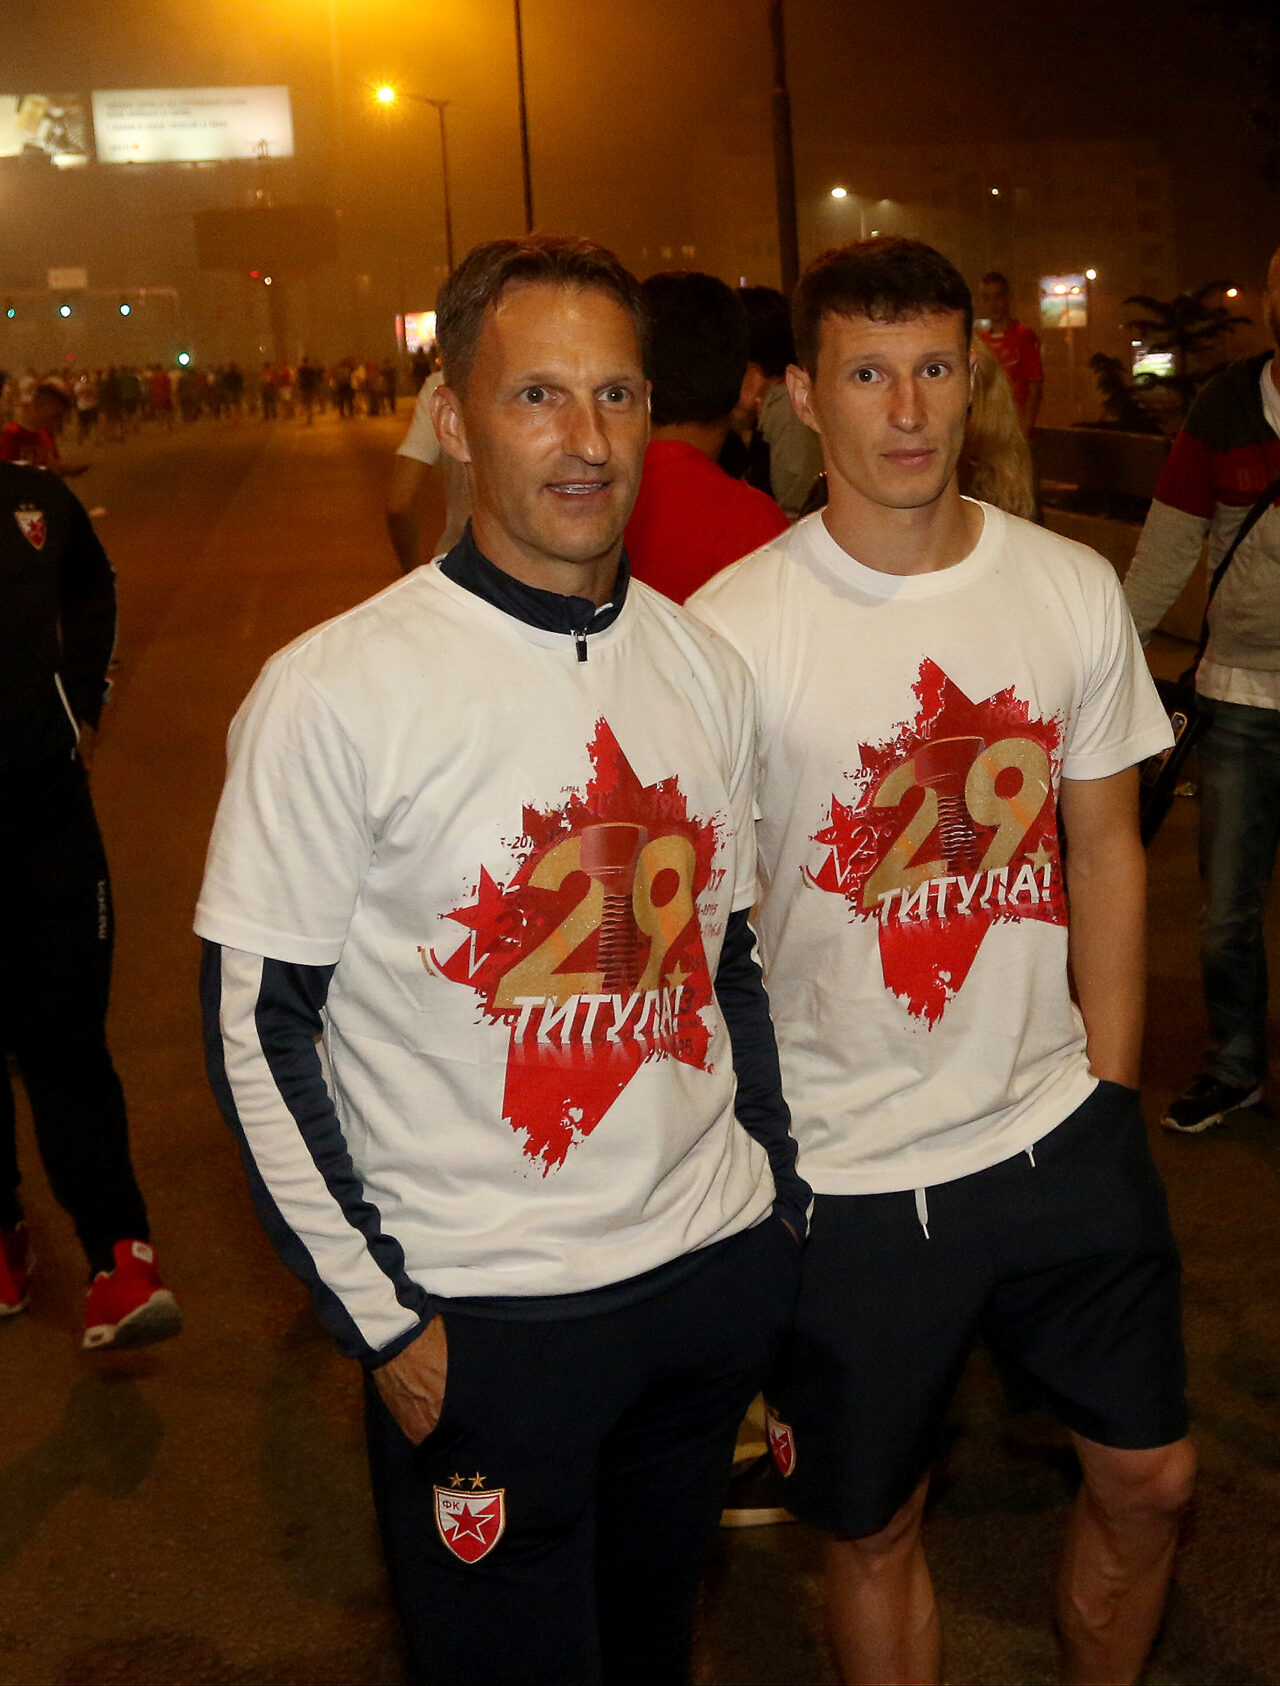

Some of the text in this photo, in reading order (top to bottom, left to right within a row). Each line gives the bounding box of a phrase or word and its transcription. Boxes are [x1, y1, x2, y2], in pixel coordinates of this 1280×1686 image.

[863, 737, 1051, 909] 29
[493, 835, 697, 1009] 29
[877, 863, 1052, 927] ТИТУЛА!
[512, 985, 685, 1045] ТИТУЛА!
[442, 1501, 460, 1511] ФК
